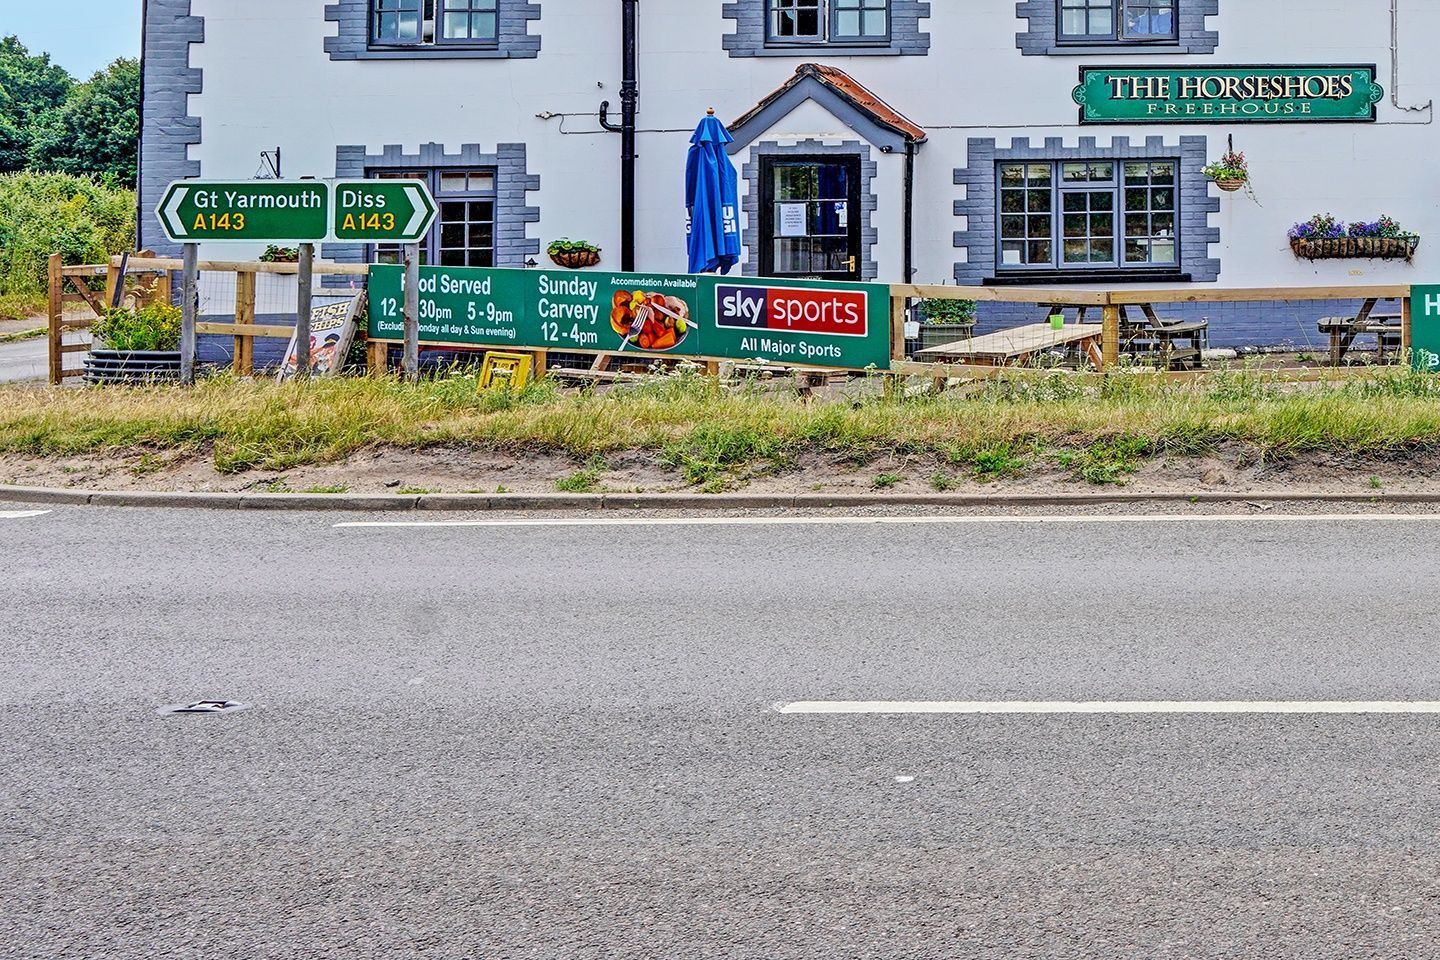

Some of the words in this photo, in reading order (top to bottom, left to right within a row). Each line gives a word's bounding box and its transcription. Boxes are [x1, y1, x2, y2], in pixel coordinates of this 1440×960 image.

[1106, 74, 1170, 100] THE
[1180, 74, 1353, 100] HORSESHOES
[1146, 102, 1312, 114] FREEHOUSE
[193, 190, 218, 208] Gt
[225, 190, 321, 208] Yarmouth
[342, 190, 386, 208] Diss
[193, 213, 245, 230] A143
[342, 213, 395, 230] A143
[440, 274, 491, 295] Served
[538, 274, 597, 301] Sunday
[610, 276, 662, 287] Accommdation
[663, 278, 697, 288] Available
[311, 301, 351, 321] FISH
[538, 298, 599, 324] Carvery
[723, 290, 764, 324] sky
[773, 297, 859, 326] sports
[418, 322, 440, 335] onday
[441, 324, 450, 334] all
[450, 325, 463, 337] day
[464, 325, 470, 335] &
[470, 325, 485, 336] Sun
[740, 337, 757, 351] All
[760, 338, 796, 356] Major
[799, 341, 842, 358] Sports
